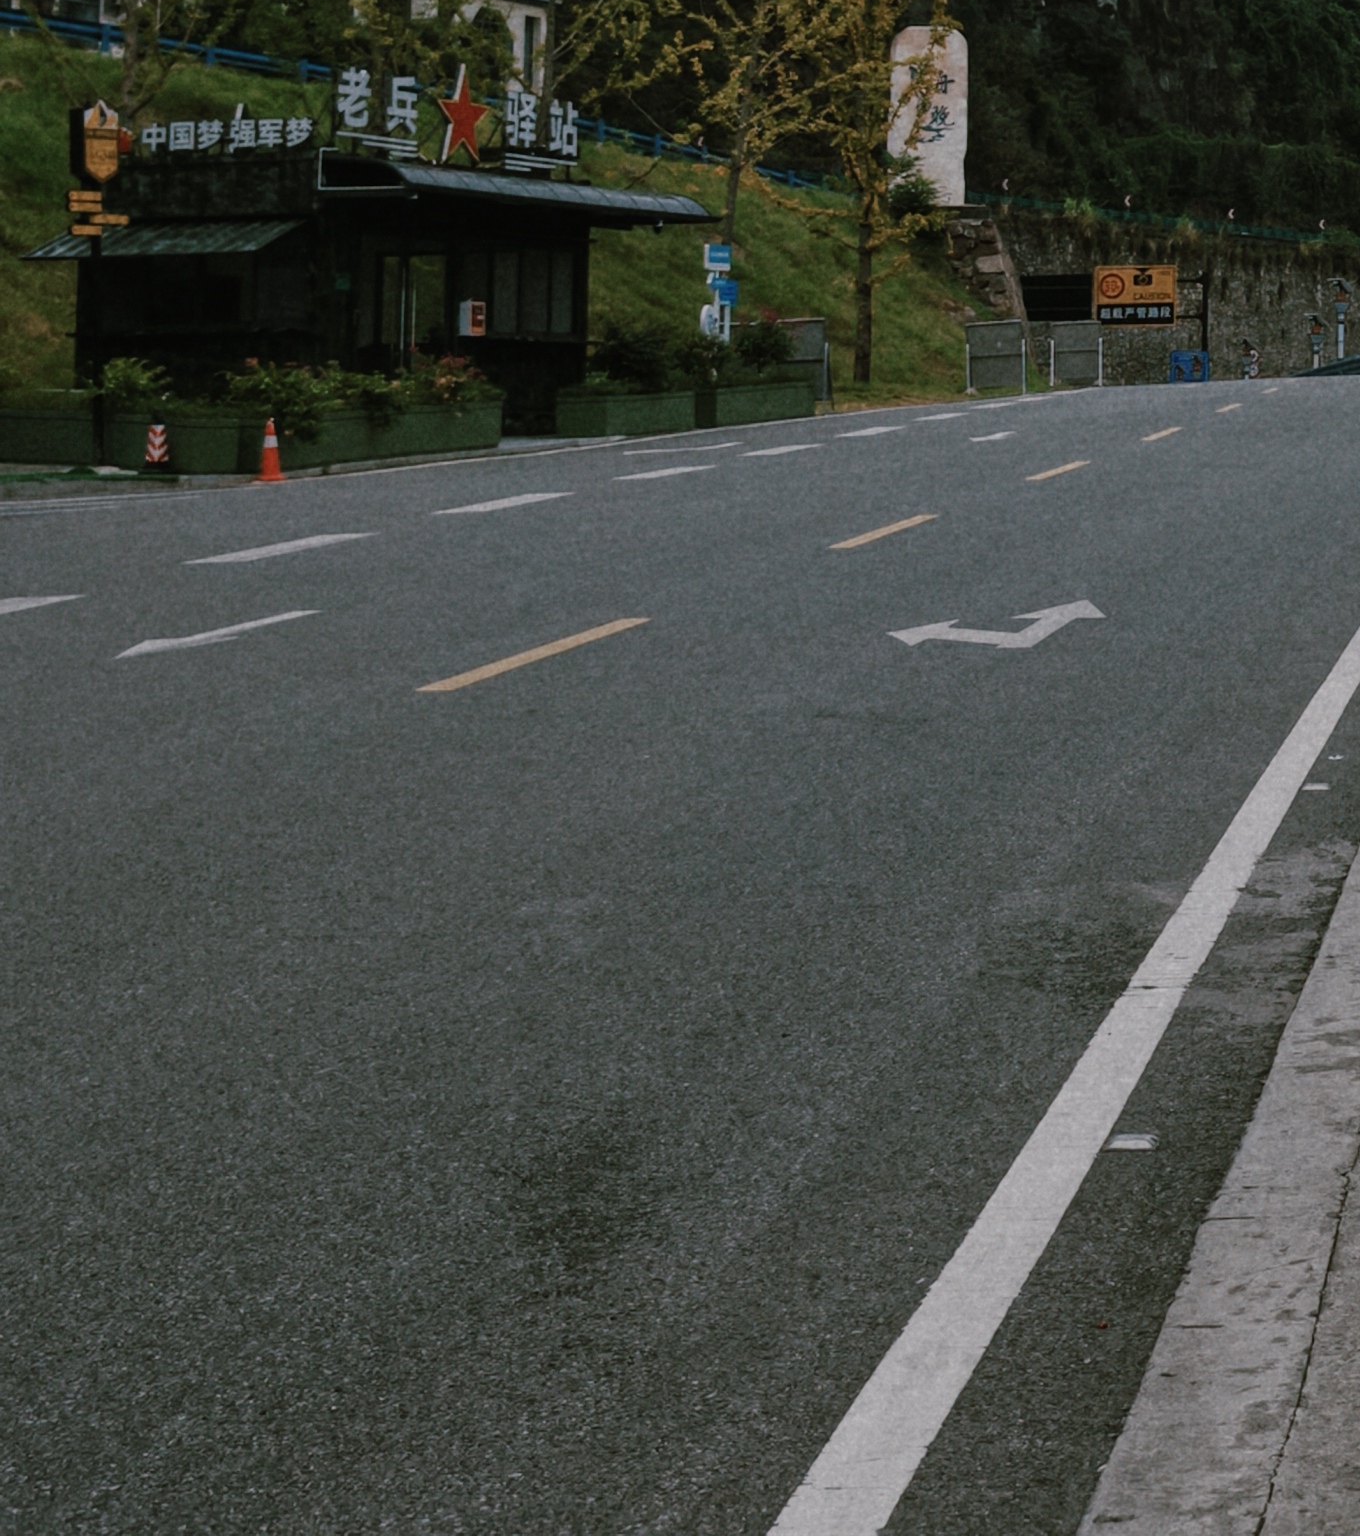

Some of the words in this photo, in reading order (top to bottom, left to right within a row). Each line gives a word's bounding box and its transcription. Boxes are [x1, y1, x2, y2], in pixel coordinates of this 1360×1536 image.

[141, 116, 313, 152] 中国梦强军梦
[337, 67, 418, 135] 老兵
[506, 90, 579, 157] 驿站
